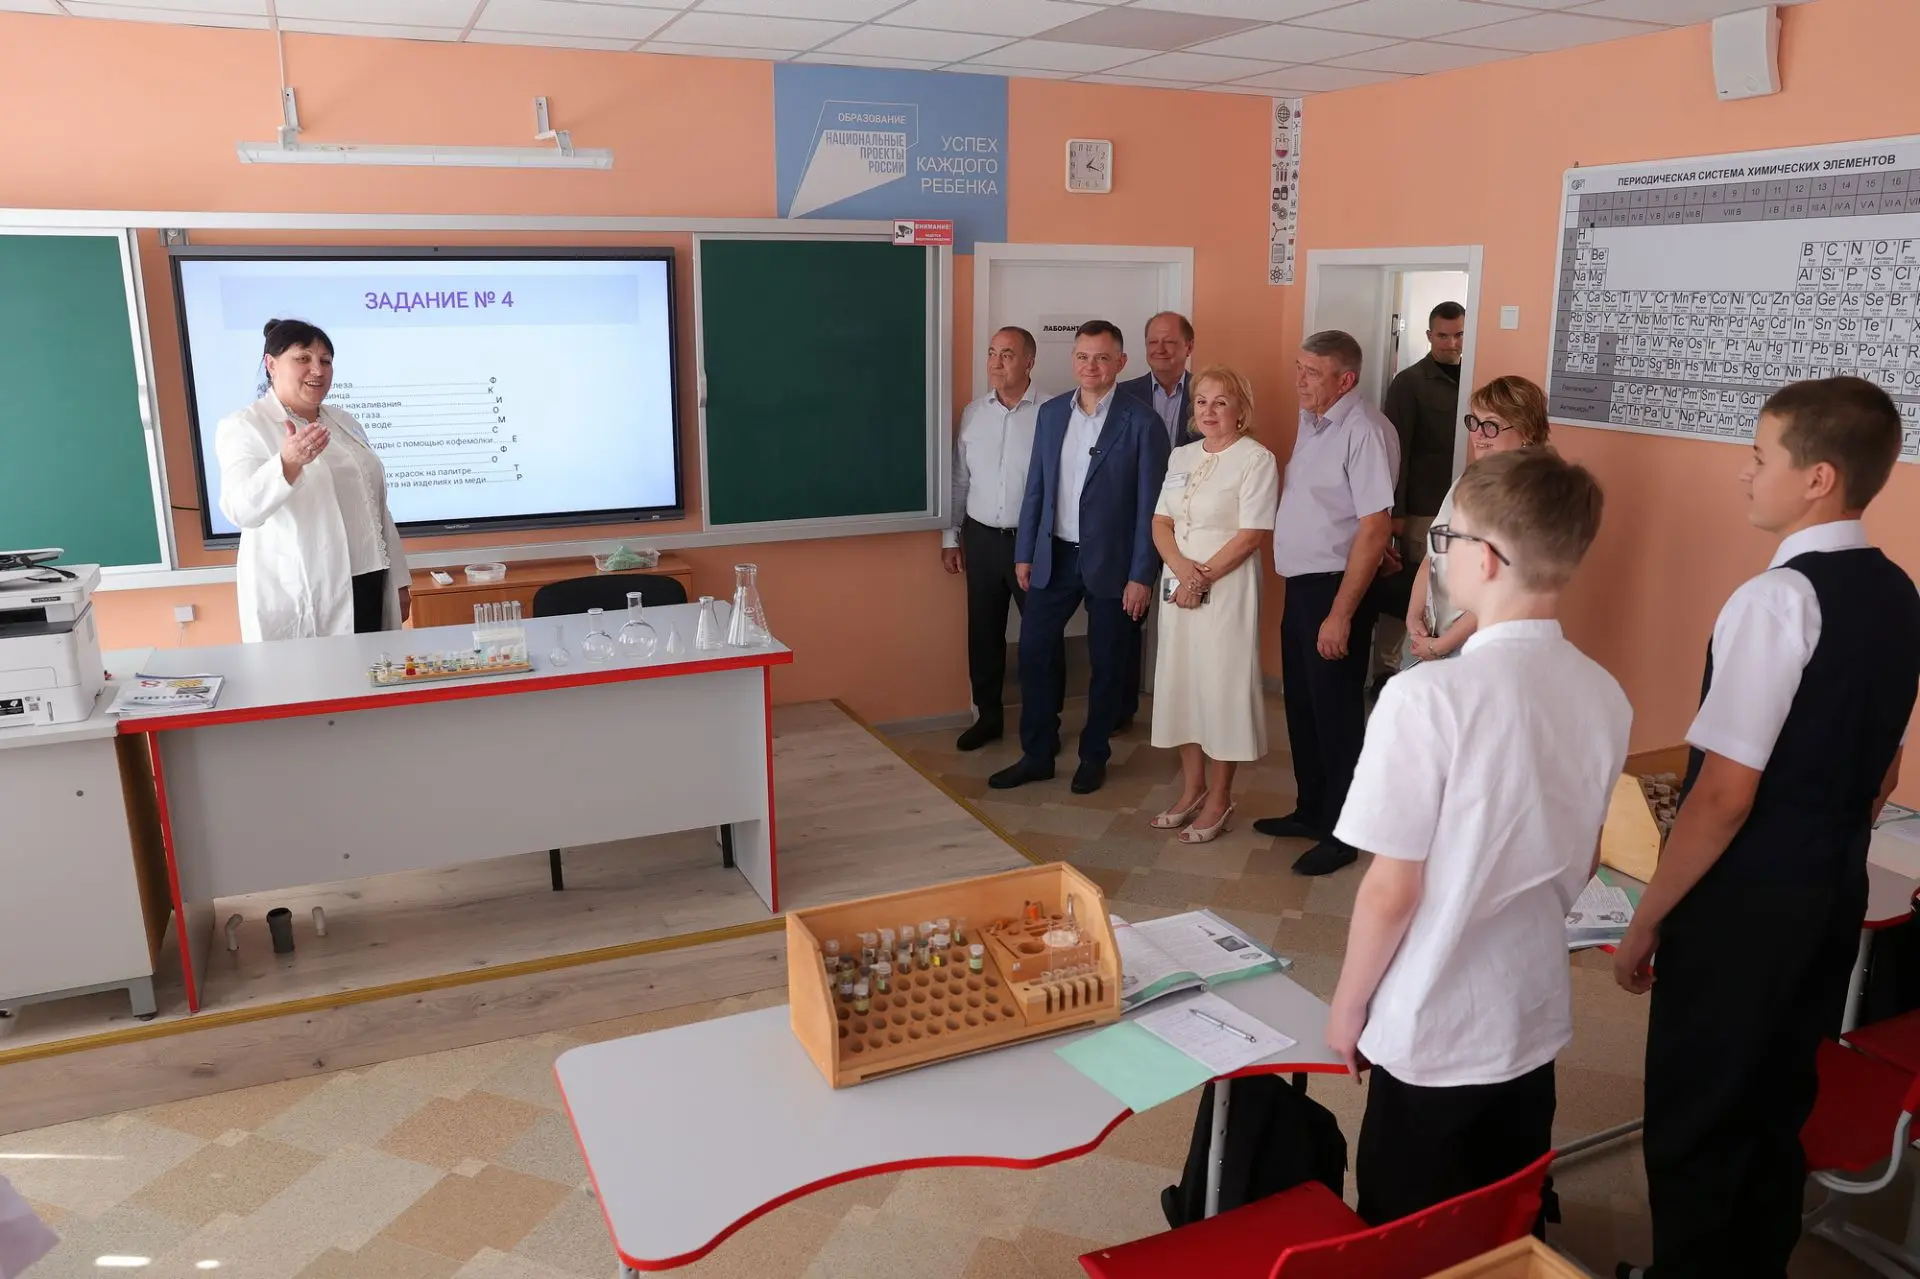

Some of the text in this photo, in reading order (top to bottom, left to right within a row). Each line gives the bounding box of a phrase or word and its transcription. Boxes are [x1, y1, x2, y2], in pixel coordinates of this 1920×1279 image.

[838, 112, 907, 125] ОБРАЗОВАНИЕ
[825, 131, 905, 147] НАЦИОНАЛЬНЫЕ
[941, 135, 999, 153] УСПЕХ
[860, 147, 905, 160] ПРОЕКТЫ
[868, 160, 905, 174] РОССИИ
[916, 156, 998, 176] КАЖДОГО
[1617, 154, 1896, 187] ПЕРИОДИЧЕСКАЯ СИСТЕМА ХИМИЧЕСКИХ ЭЛЕМЕНТОВ
[921, 177, 998, 195] РЕБЕНКА
[1794, 184, 1804, 193] 12
[1817, 183, 1827, 191] 13
[1866, 179, 1876, 188] 15
[1578, 229, 1586, 240] H
[1575, 240, 1913, 261] Li Be B C N O F
[1574, 266, 1911, 285] Na Mg Al Si P S Cl
[364, 290, 514, 313] ЗАДАНИЕ № 4
[1572, 290, 1908, 306] K Ca Sc Ti V Cr Mn Fe Co Ni Cu Zn Ga Ge As Se Br
[1571, 311, 1893, 332] Rb Sr Y Zr Nb Mo Tc Ru Rh Pd Ag Cd In Sn Sb Te I
[1568, 332, 1899, 358] Cs Ba Hf Ta W Re Os Ir Pt Au Hg Tl Pb Bi Po At
[1567, 352, 1577, 364] Fr
[1582, 353, 1595, 365] Ra
[1615, 355, 1626, 367] Rf
[1631, 356, 1645, 368] Db
[1649, 357, 1662, 372] Sg
[1667, 358, 1681, 370] Bh
[1685, 359, 1699, 372] Hs
[1704, 360, 1717, 373] Mt
[1723, 361, 1739, 374] Ds
[1744, 362, 1760, 378] Rg
[1765, 363, 1780, 376] Cn
[1785, 365, 1802, 378] Nh
[1809, 366, 1822, 379] Fl
[1880, 369, 1895, 383] Ts
[489, 376, 497, 384] Ф
[487, 386, 494, 394] К
[1612, 382, 1625, 394] La
[1629, 383, 1643, 395] Ce
[1645, 384, 1658, 396] Pr
[1664, 386, 1678, 398] Nd
[1682, 387, 1697, 399] Pm
[1701, 389, 1716, 401] Sm
[1720, 390, 1735, 403] Eu
[1741, 391, 1756, 404] Gd
[346, 401, 402, 409] накаливания
[496, 396, 503, 404] И
[1900, 404, 1916, 417] Lu
[372, 421, 393, 429] воде
[403, 439, 445, 449] помощью
[446, 437, 493, 446] кофемолки
[500, 445, 508, 453] Ф
[396, 471, 424, 479] красок
[438, 468, 472, 476] палитре
[413, 479, 452, 487] изделиях
[464, 476, 487, 485] меди
[516, 473, 523, 481] Р
